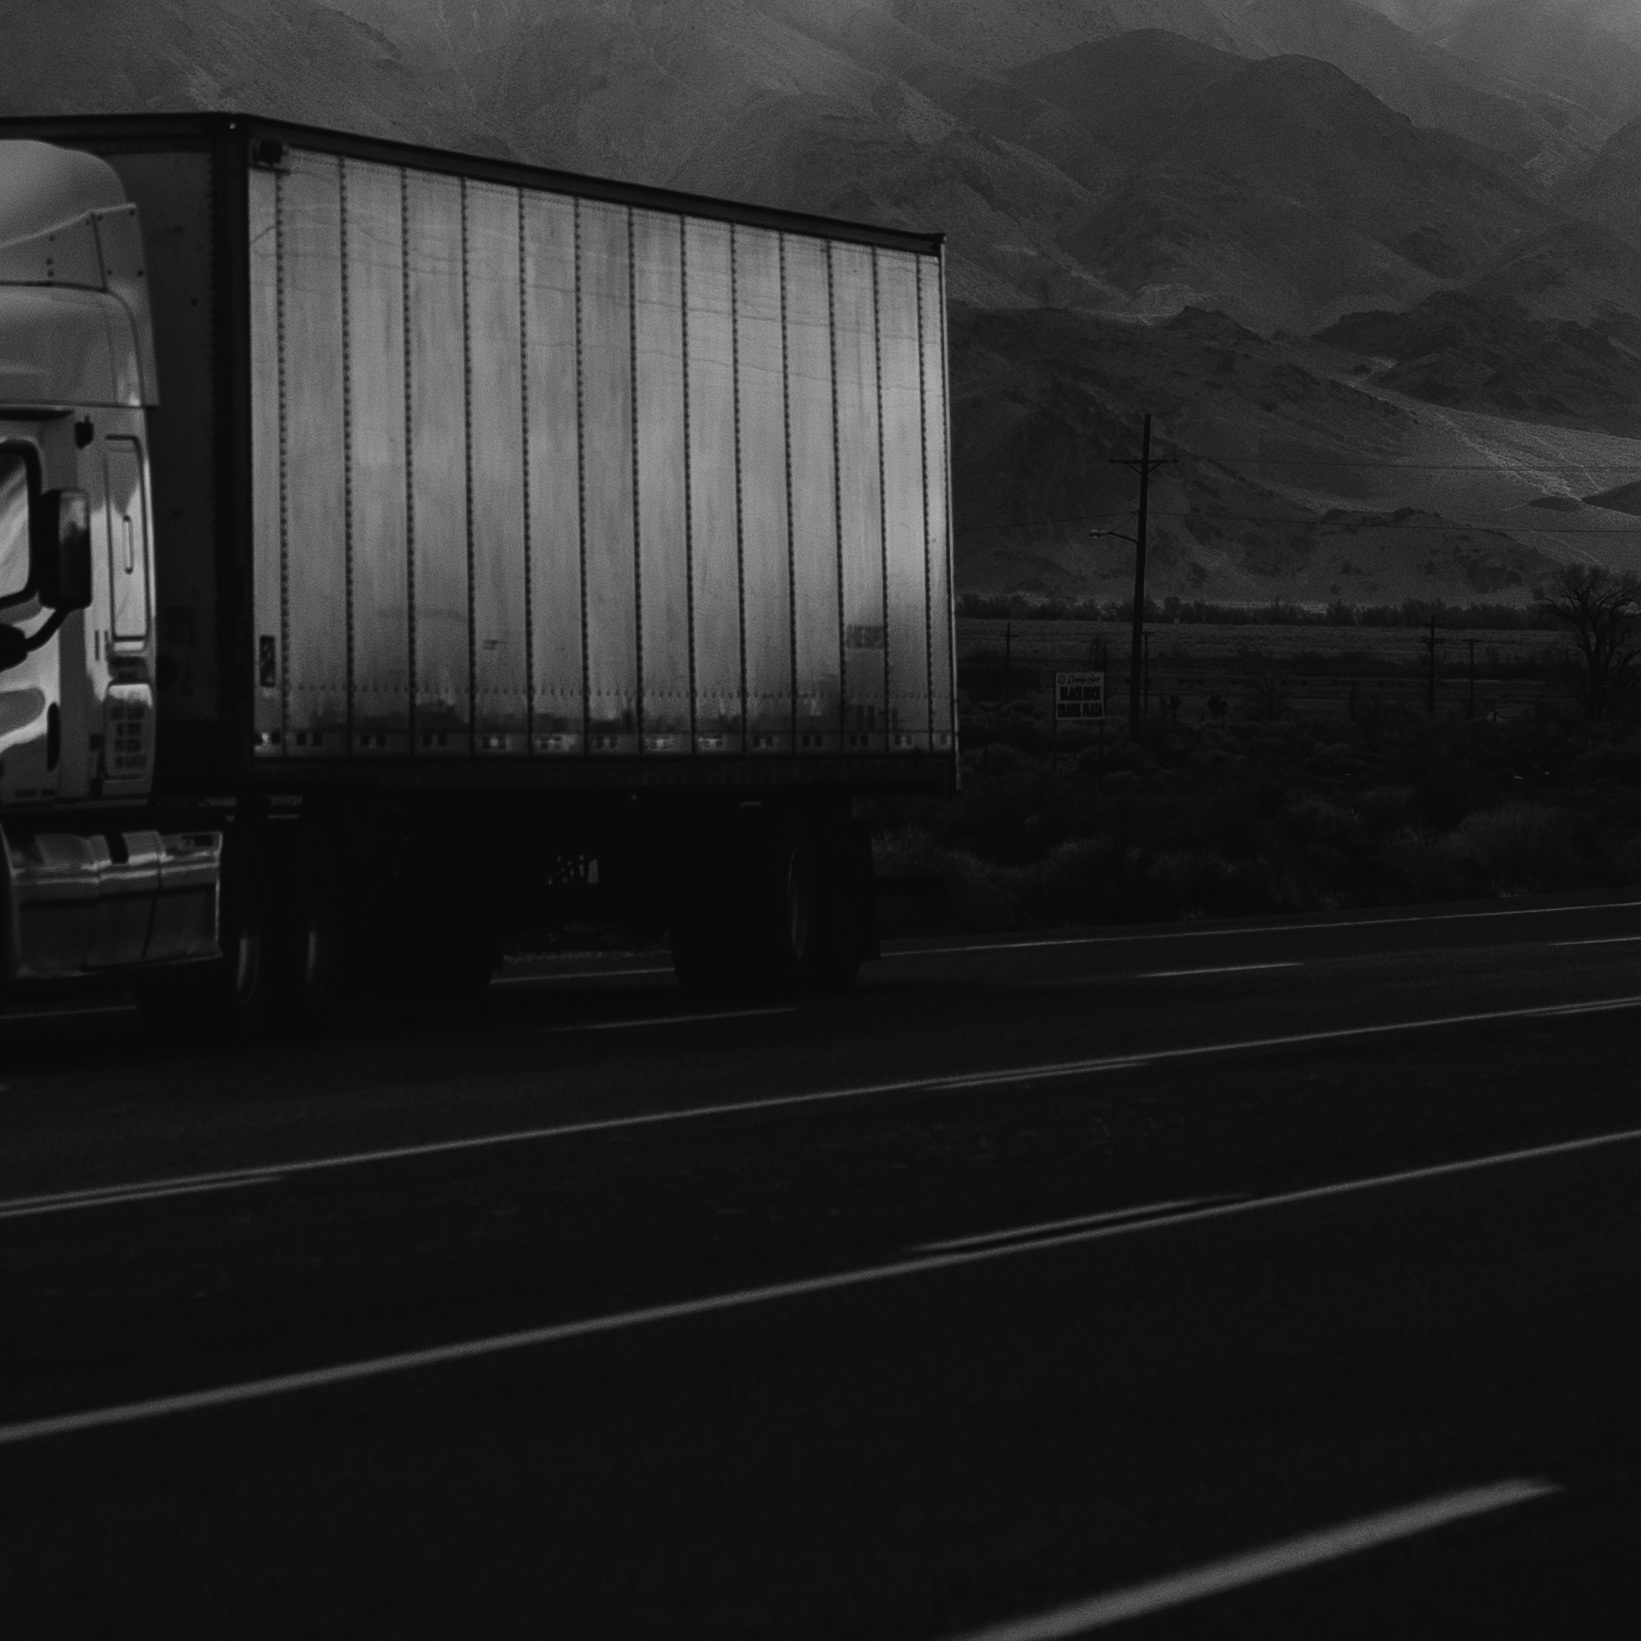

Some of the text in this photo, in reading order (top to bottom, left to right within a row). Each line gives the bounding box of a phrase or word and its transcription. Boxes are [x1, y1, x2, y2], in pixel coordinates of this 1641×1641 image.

[1060, 686, 1101, 700] BLACK ROCK
[1057, 703, 1103, 717] TRAVEL PLAZA
